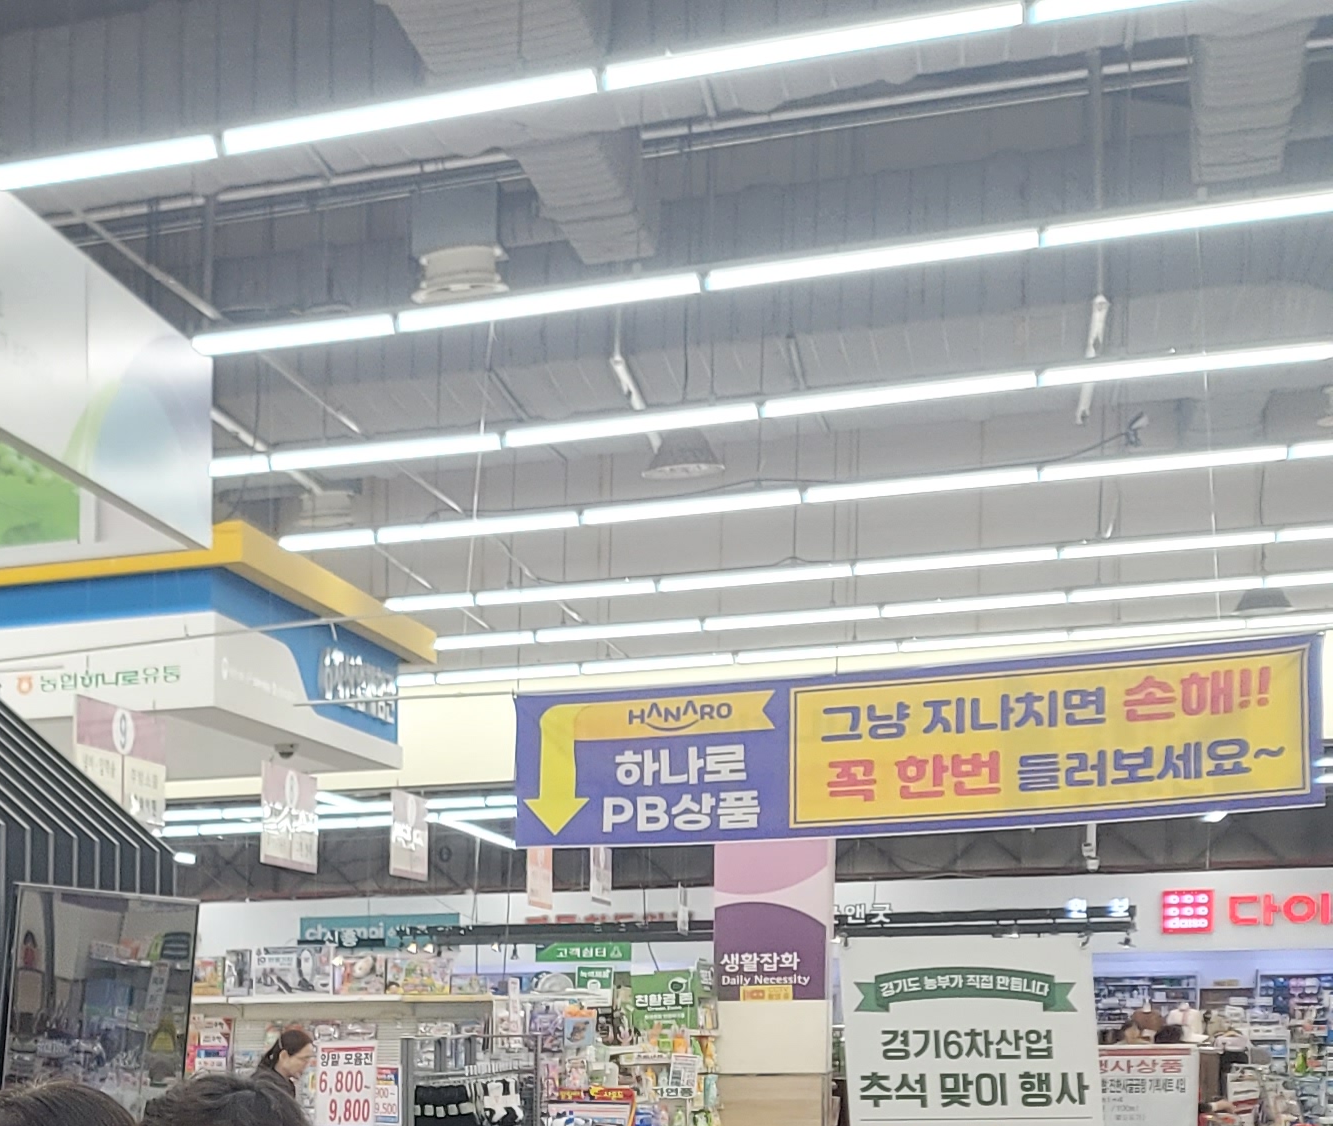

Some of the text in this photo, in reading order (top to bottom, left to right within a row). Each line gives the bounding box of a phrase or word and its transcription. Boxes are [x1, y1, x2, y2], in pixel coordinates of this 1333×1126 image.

[628, 700, 733, 725] HANARO
[820, 665, 1272, 743] 그냥 지나치면 손해!!
[614, 743, 747, 787] 하나로
[826, 737, 1287, 802] 꼭 한번 들러보세요~
[601, 789, 761, 834] PB상품
[1228, 891, 1333, 926] 다이
[555, 946, 607, 959] 고객쉼터
[719, 951, 801, 973] 생활잡화
[721, 974, 810, 987] Daily Necessity
[879, 973, 1051, 997] 경기도 농부가 직접 만듭니다
[320, 1051, 373, 1067] 양말 모음전
[880, 1027, 1054, 1061] 경기6차산업
[859, 1071, 929, 1108] 추석
[939, 1072, 1009, 1108] 맞이
[1019, 1070, 1090, 1108] 행사
[329, 1098, 370, 1125] 9,800
